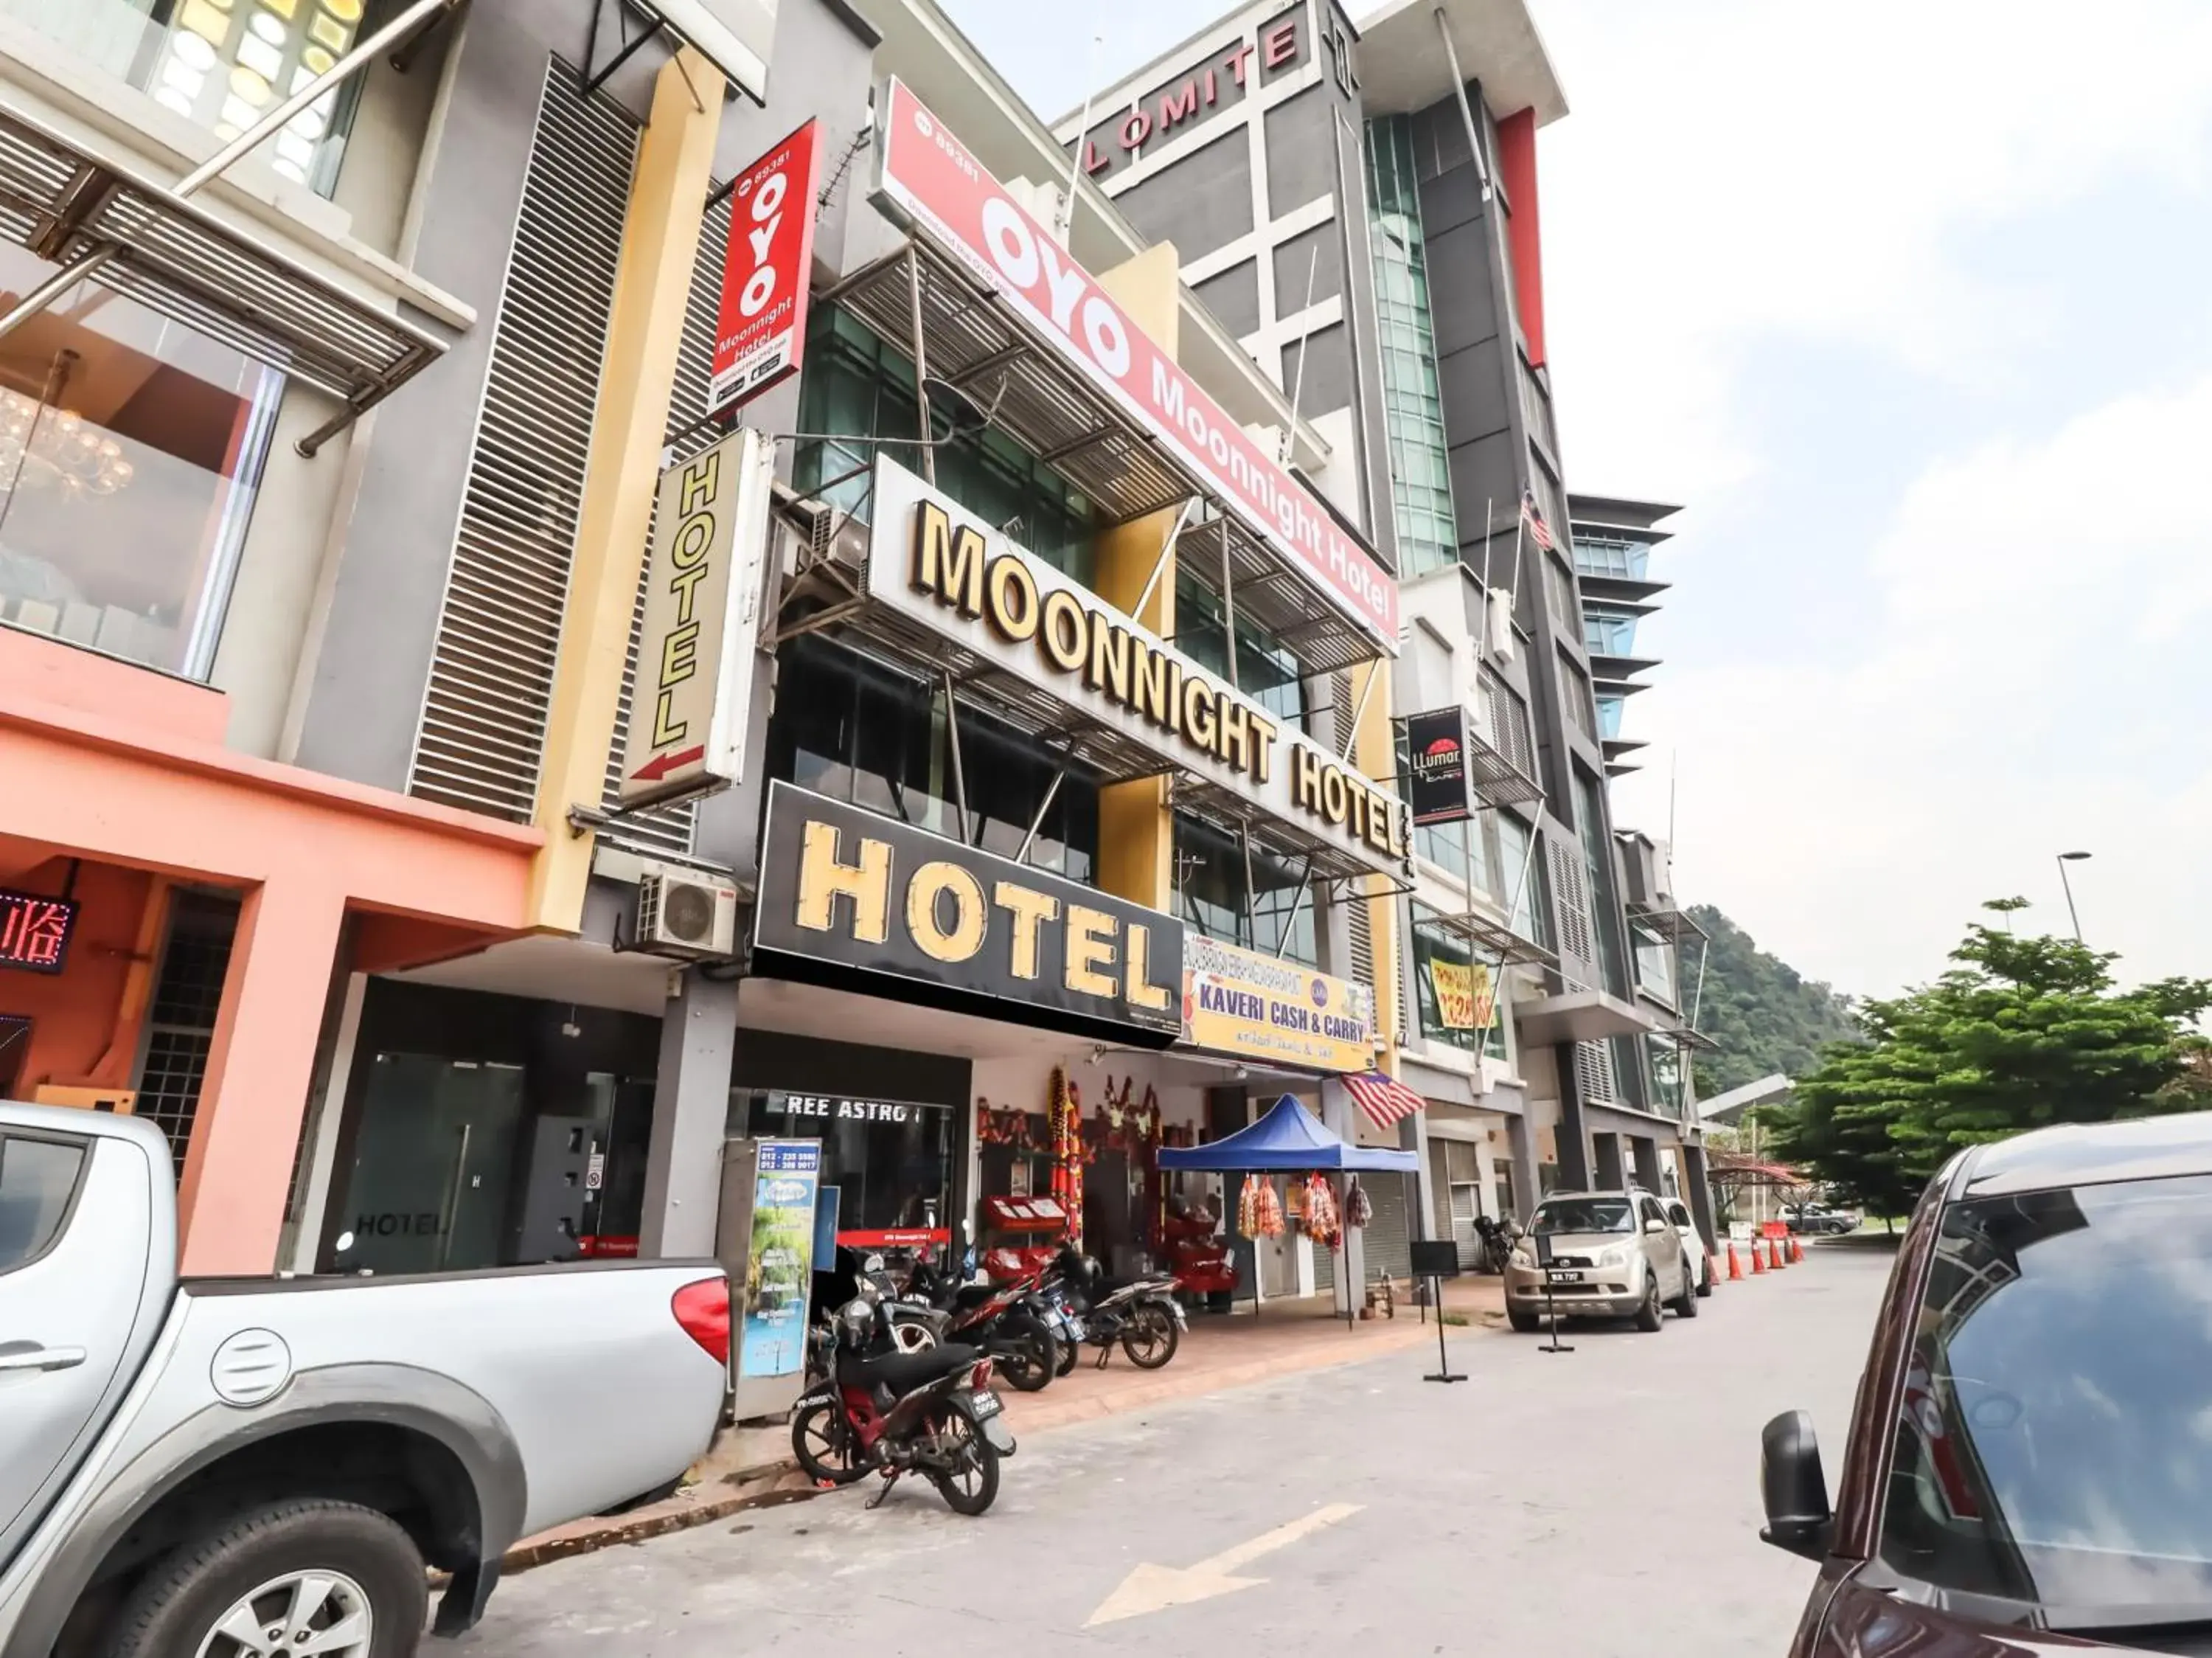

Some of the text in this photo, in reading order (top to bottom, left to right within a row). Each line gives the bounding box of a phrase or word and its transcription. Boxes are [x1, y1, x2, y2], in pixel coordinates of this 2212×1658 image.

[754, 150, 790, 184] 89381
[740, 172, 787, 317] OYO
[719, 296, 793, 355] Moonnight
[734, 329, 771, 362] Hotel
[982, 197, 1388, 622] OYO Moonnight Hotel
[650, 450, 720, 750] HOTEL
[916, 499, 1404, 859] MOONNIGHT HOTEL
[1412, 750, 1461, 771] LLumar
[796, 819, 1171, 1011] HOTEL
[1200, 983, 1264, 1021] KAVERI
[1270, 1000, 1308, 1031] CASH
[1311, 1013, 1321, 1033] &
[1324, 1014, 1364, 1044] CARRY
[785, 1095, 830, 1116] REE
[355, 1213, 449, 1237] HOTEL
